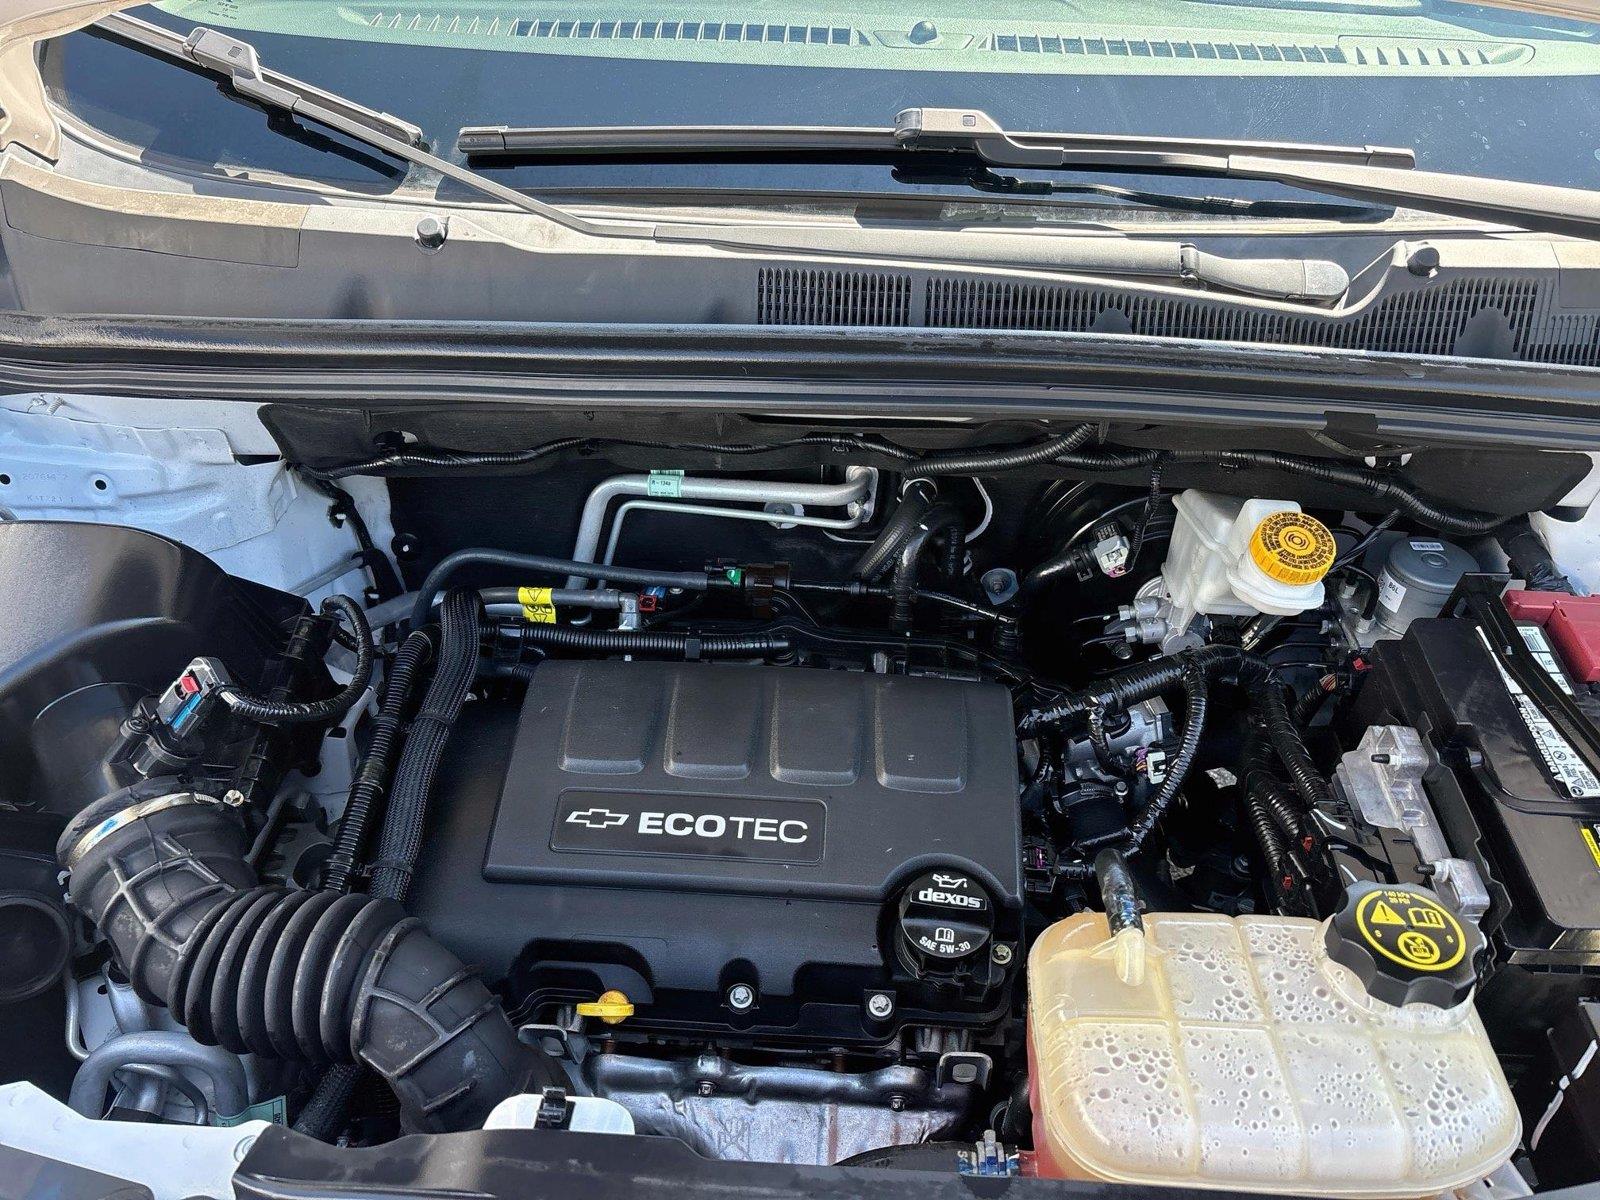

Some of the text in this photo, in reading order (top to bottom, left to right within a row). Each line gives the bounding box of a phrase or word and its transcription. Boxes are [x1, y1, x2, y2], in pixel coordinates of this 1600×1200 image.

[638, 811, 809, 844] ECOTEC
[918, 887, 983, 909] dexos
[919, 936, 971, 954] SAE 5W-30
